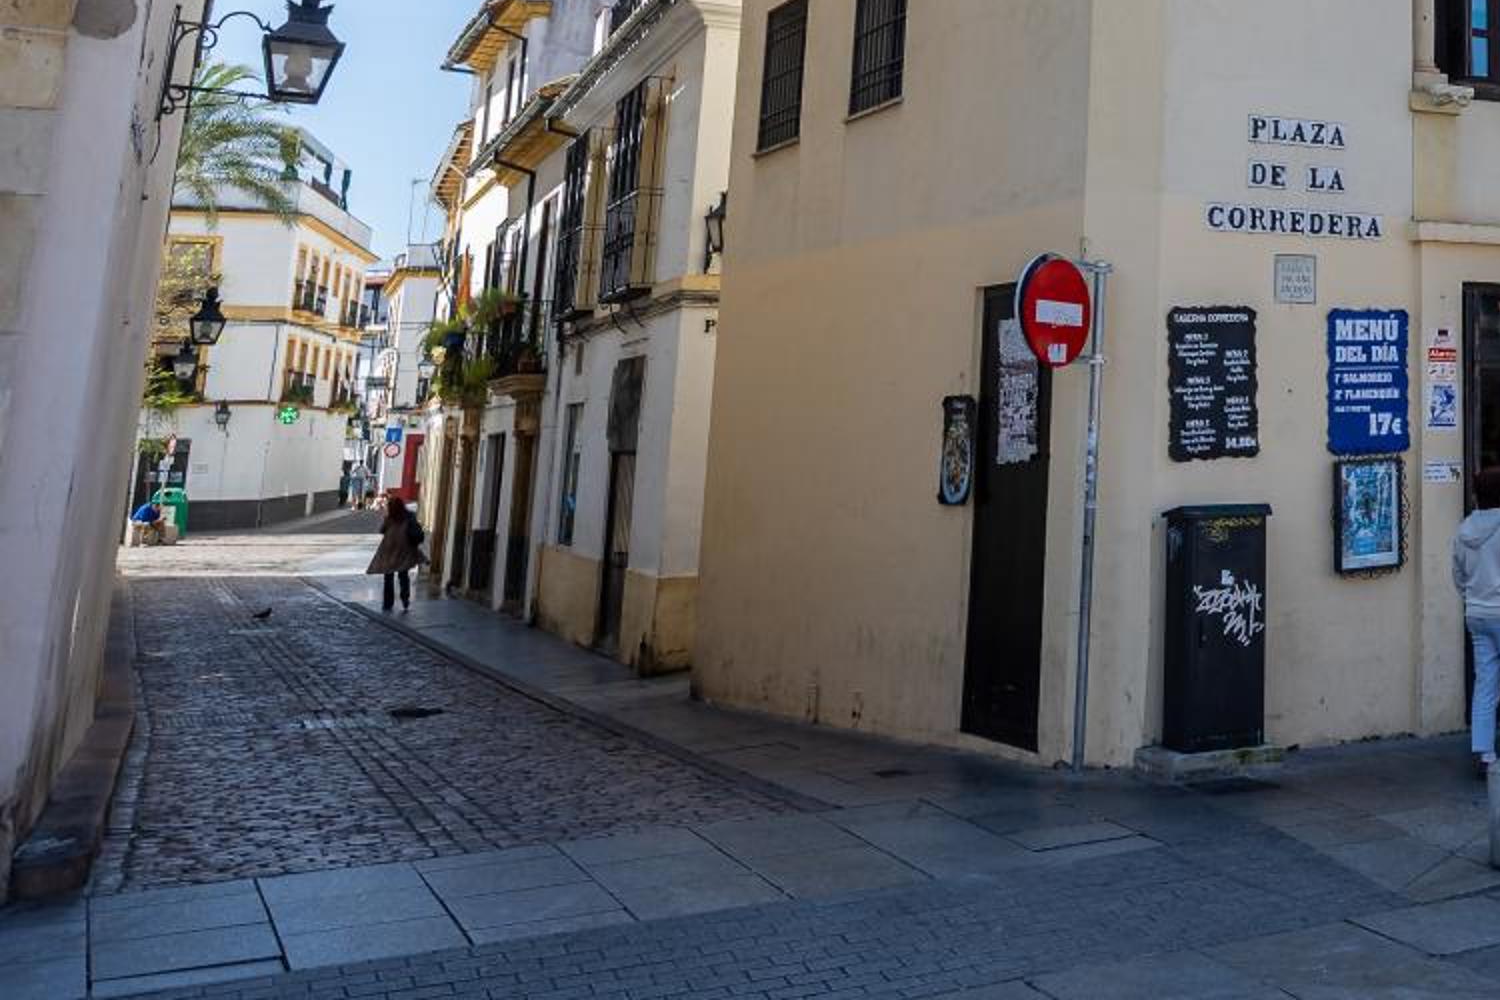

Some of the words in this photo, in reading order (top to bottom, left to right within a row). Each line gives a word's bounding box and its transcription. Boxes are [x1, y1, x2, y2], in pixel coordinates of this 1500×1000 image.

[1250, 117, 1345, 146] PLAZA
[1251, 163, 1286, 187] DE
[1309, 167, 1345, 191] LA
[1207, 206, 1382, 237] CORREDERA
[1335, 313, 1399, 342] MENÚ
[1335, 345, 1367, 363] DEL
[1371, 343, 1399, 363] DÍA
[1369, 412, 1403, 437] 17€
